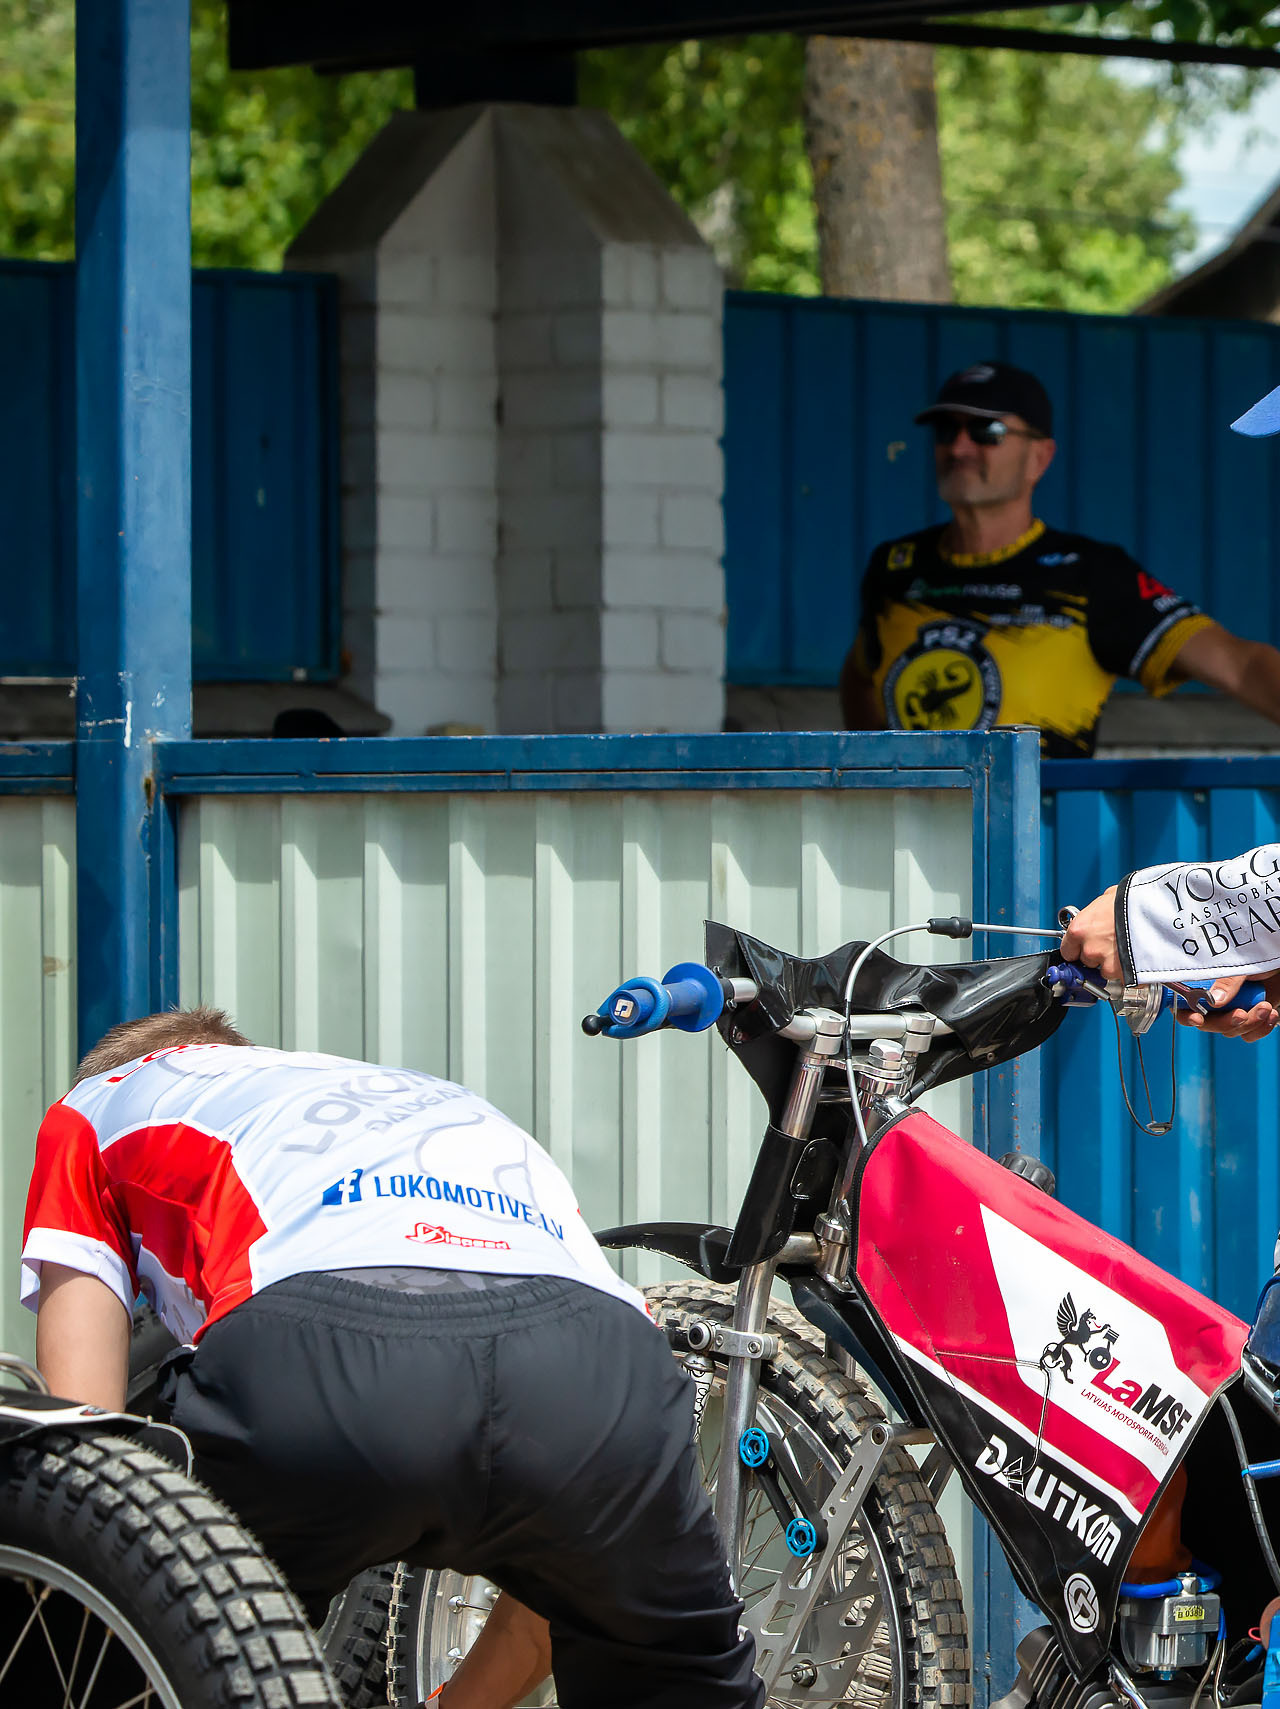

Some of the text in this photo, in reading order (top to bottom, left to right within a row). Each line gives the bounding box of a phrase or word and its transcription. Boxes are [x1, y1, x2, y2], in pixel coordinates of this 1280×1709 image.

[374, 1174, 564, 1241] LOKOMOTIVE.LV
[1090, 1356, 1192, 1440] LaMSF
[1110, 1408, 1153, 1441] MOTOSPORTA
[975, 1434, 1122, 1567] DAUTKOM
